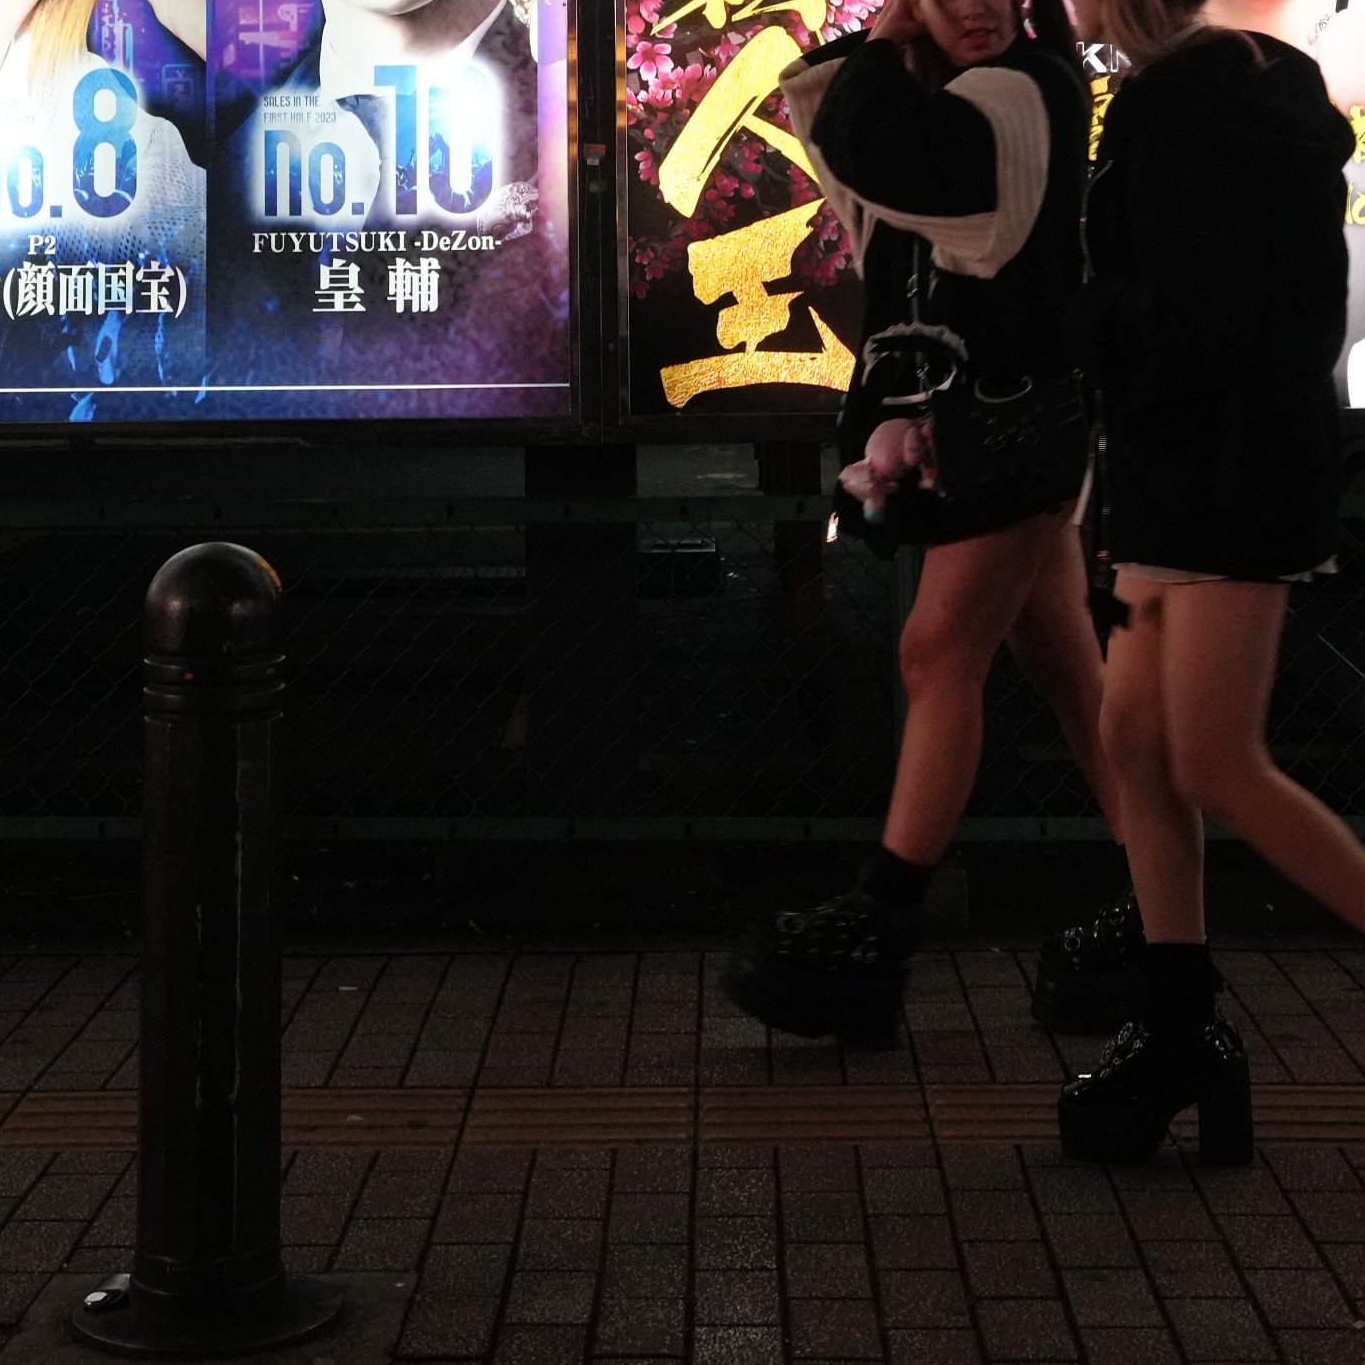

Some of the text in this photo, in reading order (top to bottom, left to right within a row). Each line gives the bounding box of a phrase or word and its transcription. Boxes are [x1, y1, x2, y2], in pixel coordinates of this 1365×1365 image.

[263, 95, 291, 108] SALES
[304, 95, 320, 108] THE
[27, 234, 57, 256] P2
[251, 230, 502, 255] FUYUTSUKI -DeZon-
